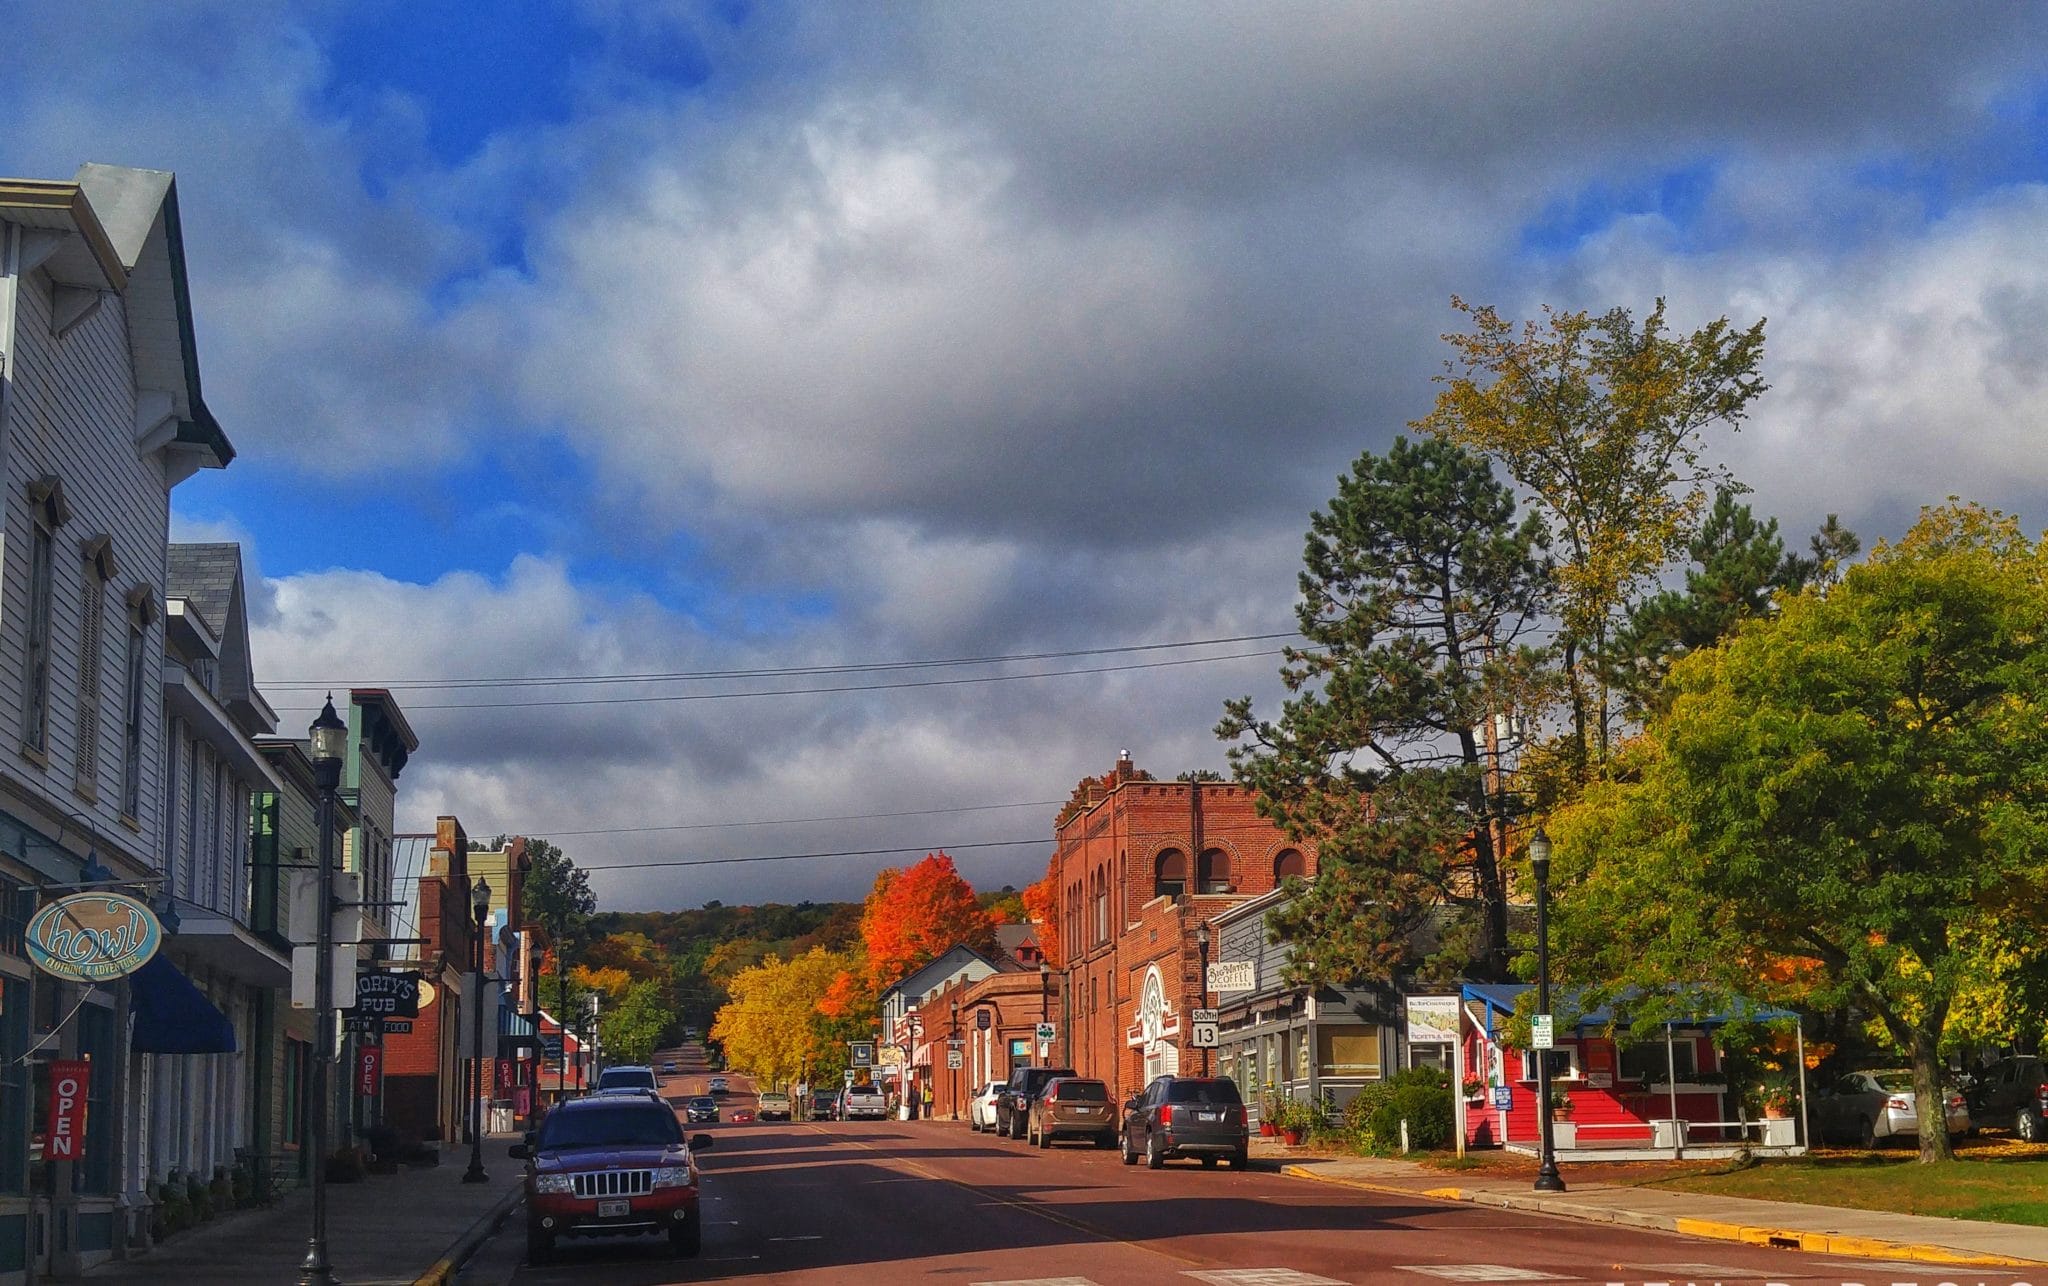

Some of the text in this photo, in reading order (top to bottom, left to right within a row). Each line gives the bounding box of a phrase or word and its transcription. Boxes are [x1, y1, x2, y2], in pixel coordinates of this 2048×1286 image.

[47, 908, 139, 961] howl
[45, 954, 141, 976] CLOTHING & ADVENTURE
[1207, 967, 1225, 983] BIG
[1217, 971, 1249, 983] COFFEE
[361, 998, 396, 1012] PUB
[1194, 1011, 1217, 1020] SOUTH
[349, 1021, 370, 1031] ATM
[384, 1022, 410, 1032] FOOD
[1197, 1028, 1214, 1043] 13
[949, 1060, 961, 1068] 25
[362, 1055, 375, 1094] OPEN
[502, 1063, 511, 1088] OPEN
[53, 1078, 78, 1155] OPEN
